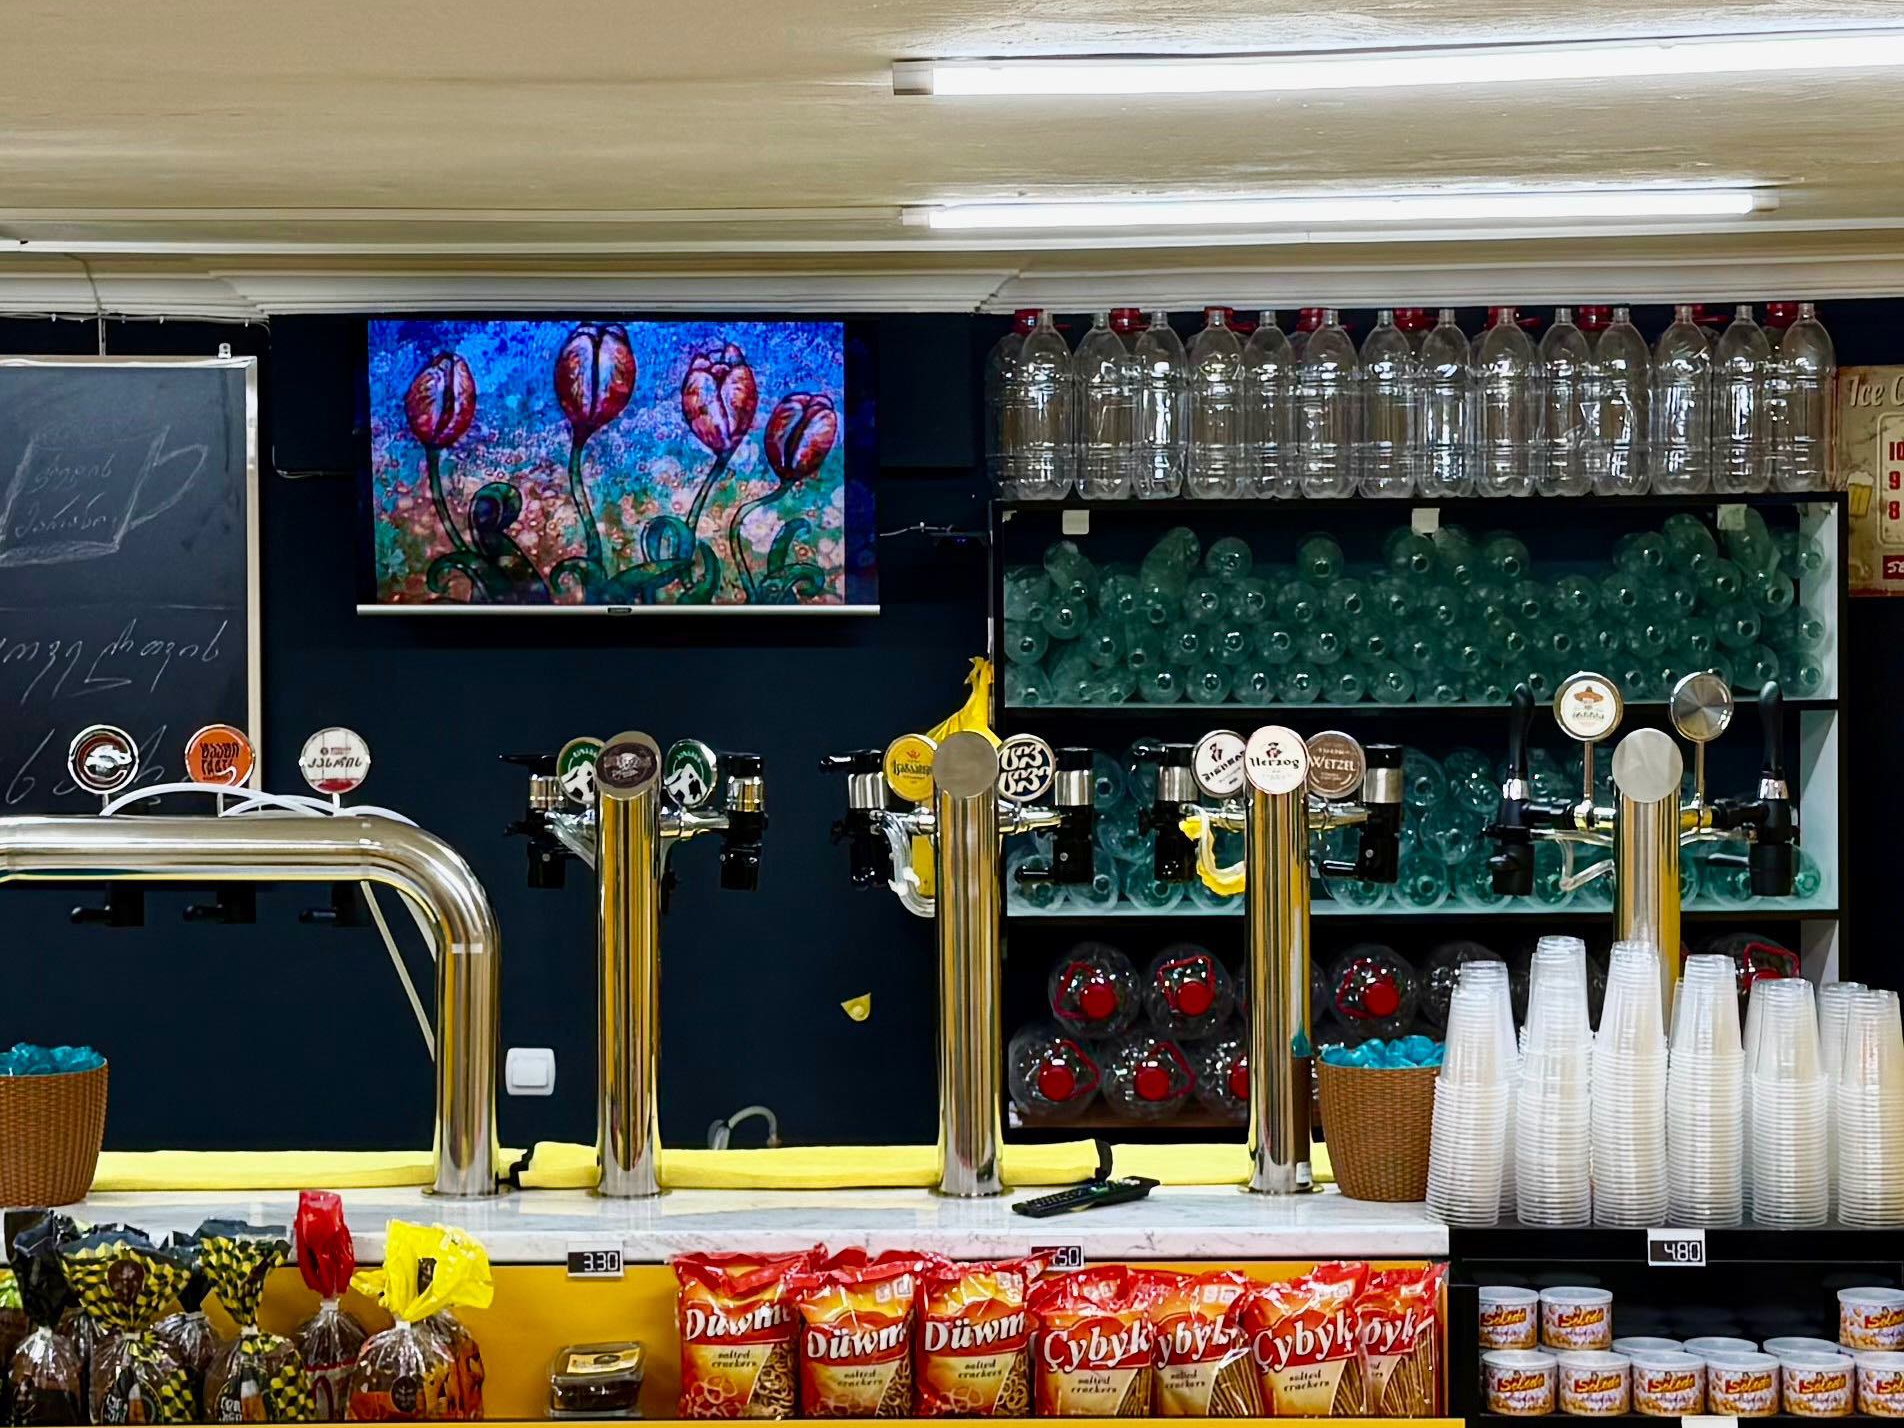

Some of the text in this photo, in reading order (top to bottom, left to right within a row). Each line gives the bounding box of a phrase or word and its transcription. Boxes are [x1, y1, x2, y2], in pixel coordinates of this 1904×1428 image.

[1849, 374, 1885, 407] Ice
[1889, 471, 1901, 490] 9
[1889, 501, 1901, 520] 8
[307, 755, 364, 769] კასრის
[1249, 756, 1300, 769] Herzog
[1311, 754, 1356, 772] WETZEL
[1043, 1319, 1150, 1373] Çybyk
[964, 1360, 997, 1370] salted
